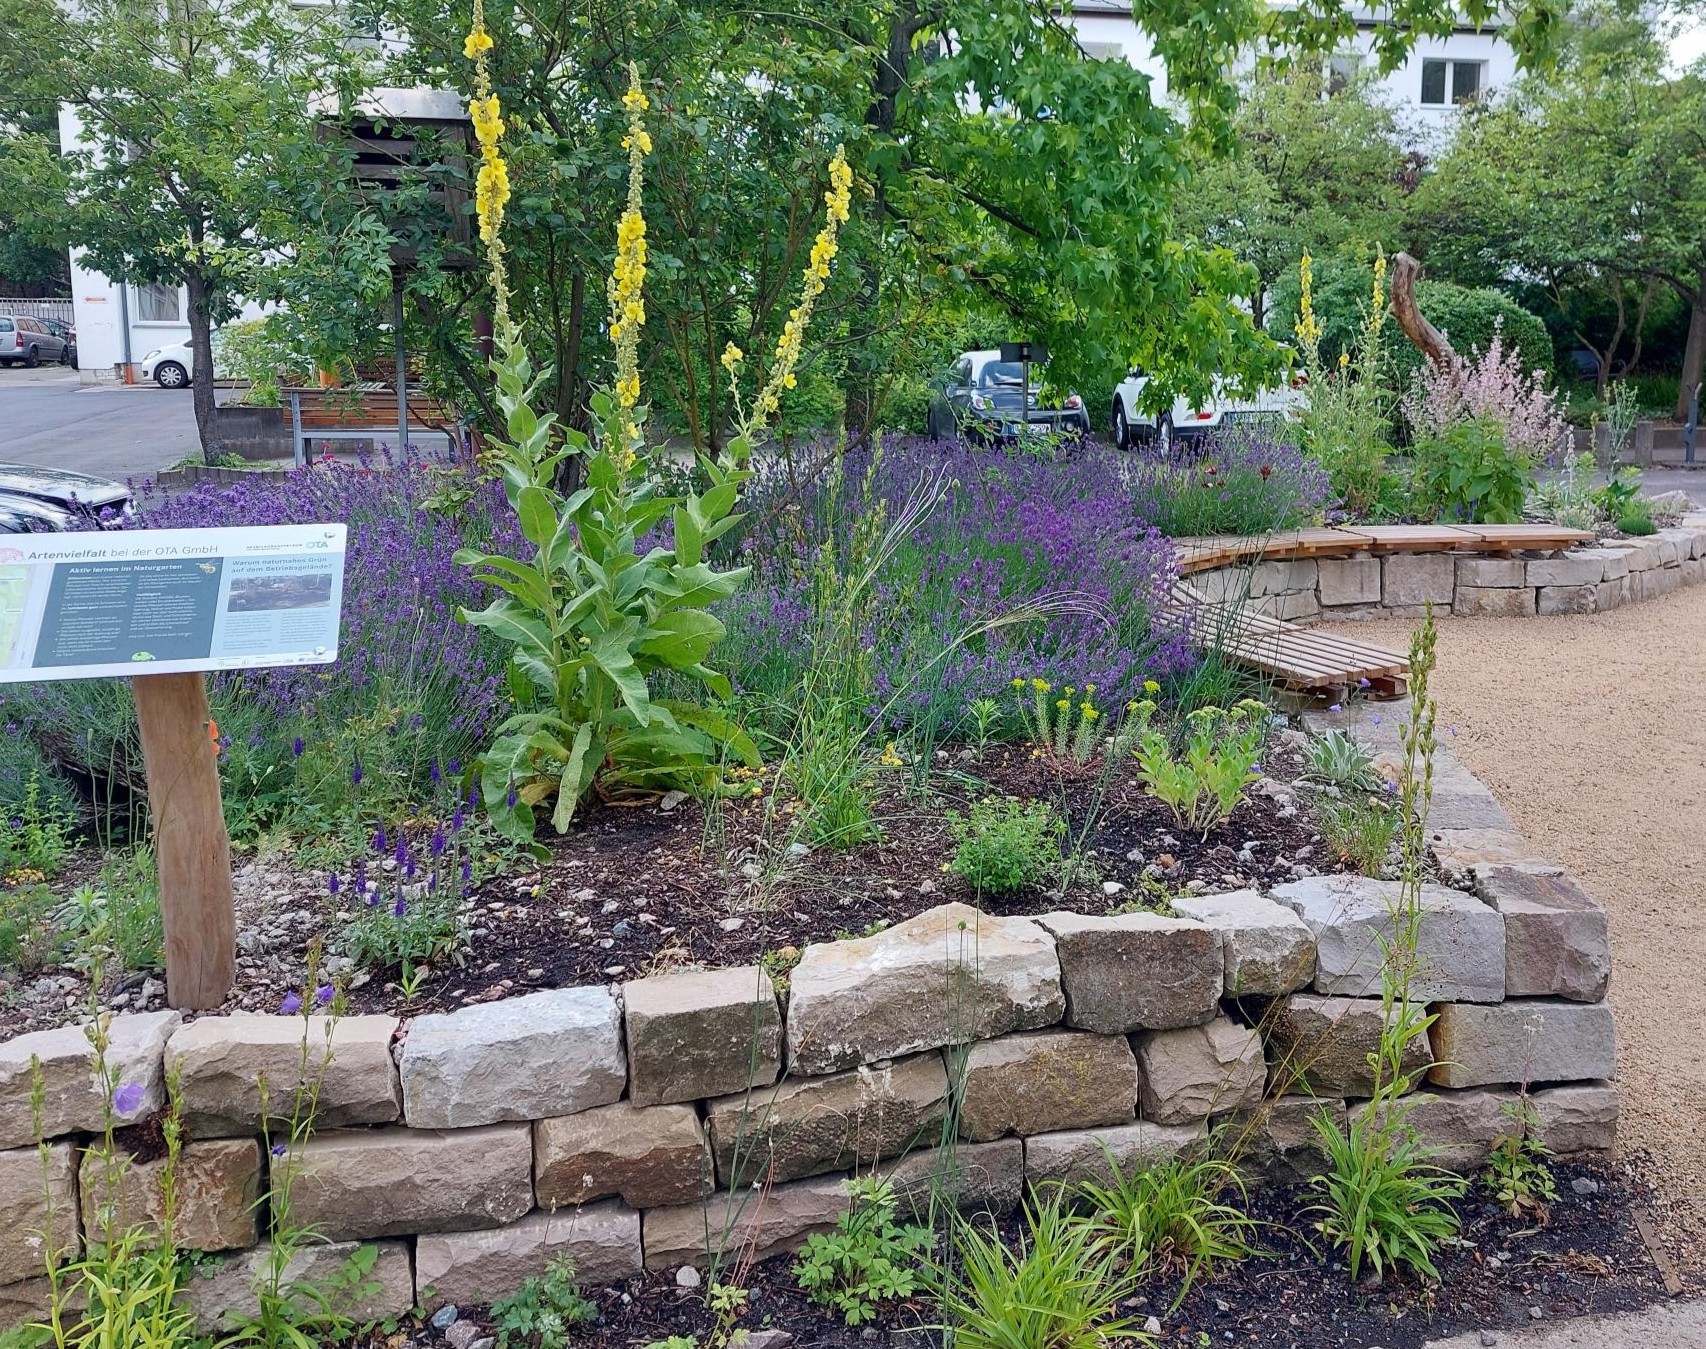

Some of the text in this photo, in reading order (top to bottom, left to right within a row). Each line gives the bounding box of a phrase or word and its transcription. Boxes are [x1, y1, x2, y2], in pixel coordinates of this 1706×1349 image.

[305, 541, 328, 549] OTA
[28, 545, 219, 560] Artenvielfalt bei der OTA GmbH
[133, 564, 183, 572] Naturgarten
[265, 563, 332, 572] Betriebsgelände?
